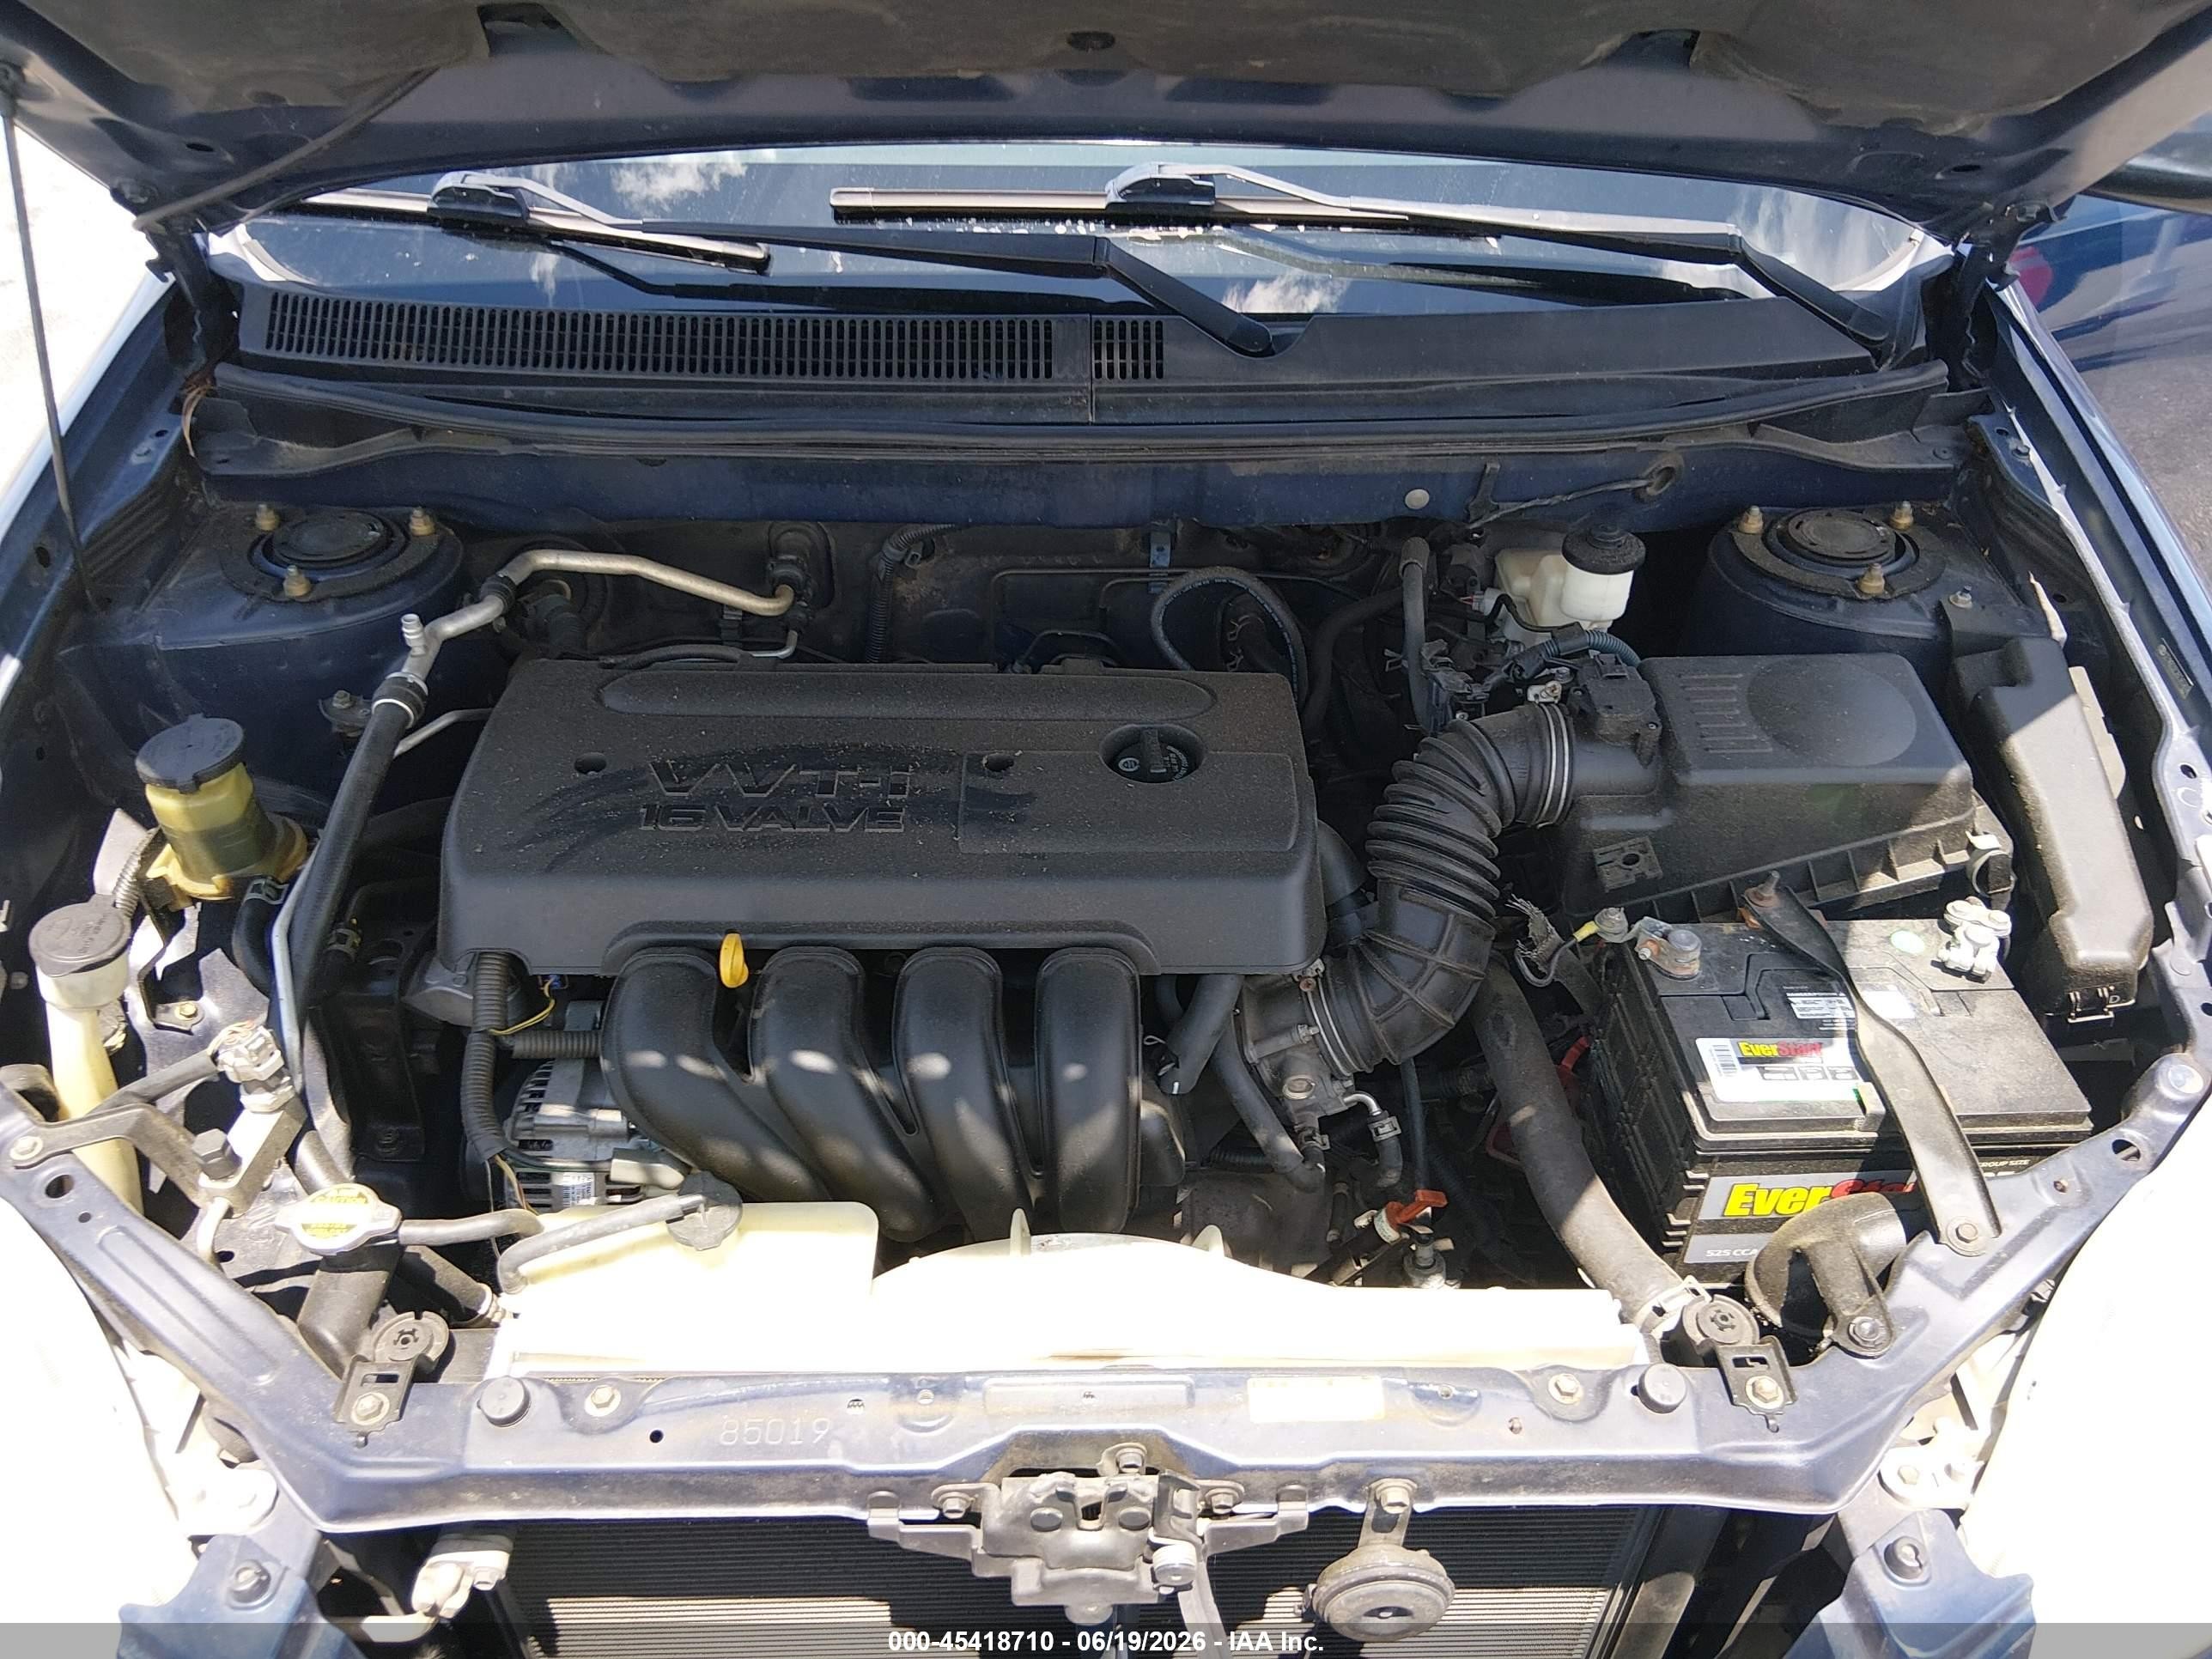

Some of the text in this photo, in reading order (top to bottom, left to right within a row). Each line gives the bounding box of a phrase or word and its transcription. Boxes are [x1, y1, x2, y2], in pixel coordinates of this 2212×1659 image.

[639, 803, 906, 833] 16 VALVE
[1736, 1039, 1824, 1058] EverStart
[1705, 1249, 1732, 1257] 525
[719, 1417, 831, 1446] 85019
